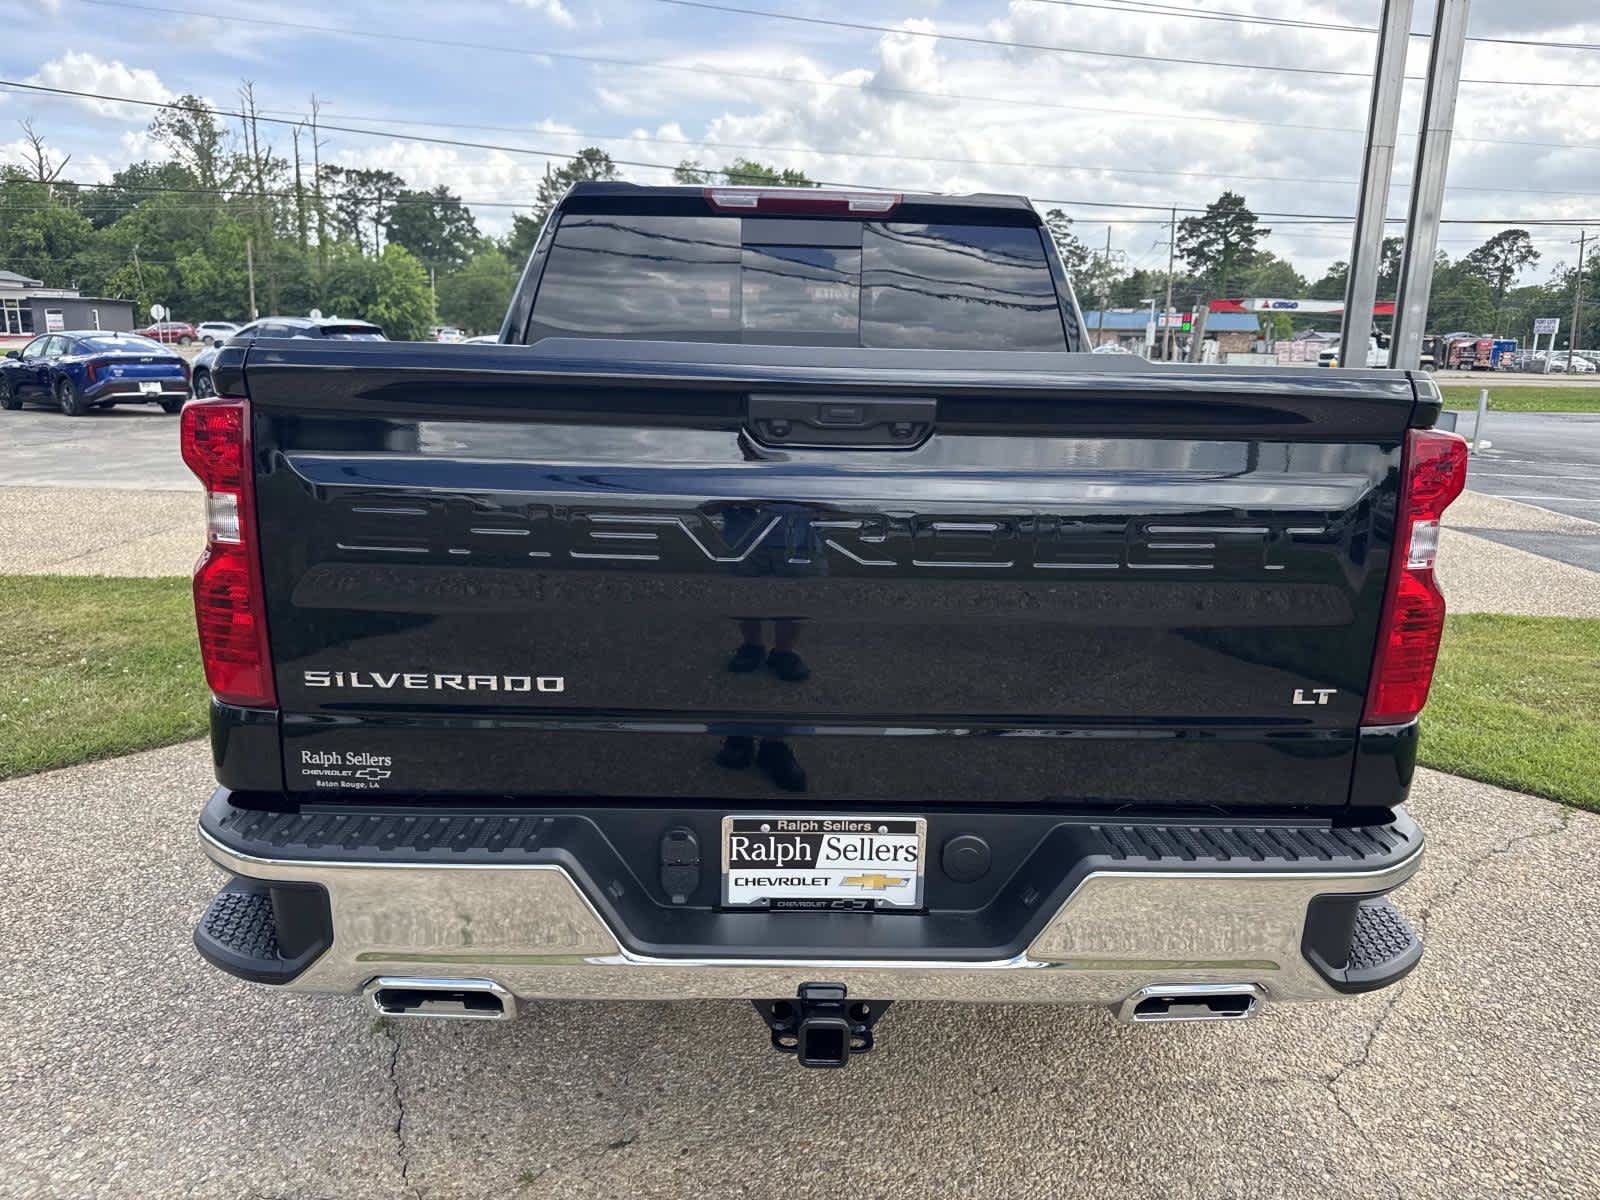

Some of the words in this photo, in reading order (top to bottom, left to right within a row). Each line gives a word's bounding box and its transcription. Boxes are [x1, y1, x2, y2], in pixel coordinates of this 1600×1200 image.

[331, 495, 1330, 571] CHEVROLET
[304, 671, 564, 692] SILVERADO
[1293, 689, 1337, 704] LT
[301, 751, 341, 767] Ralph
[346, 752, 391, 766] Sellers
[777, 820, 818, 831] Ralph
[823, 821, 871, 831] Sellers
[730, 836, 812, 867] Ralph
[826, 837, 917, 862] Sellers
[734, 877, 831, 886] CHEVROLET
